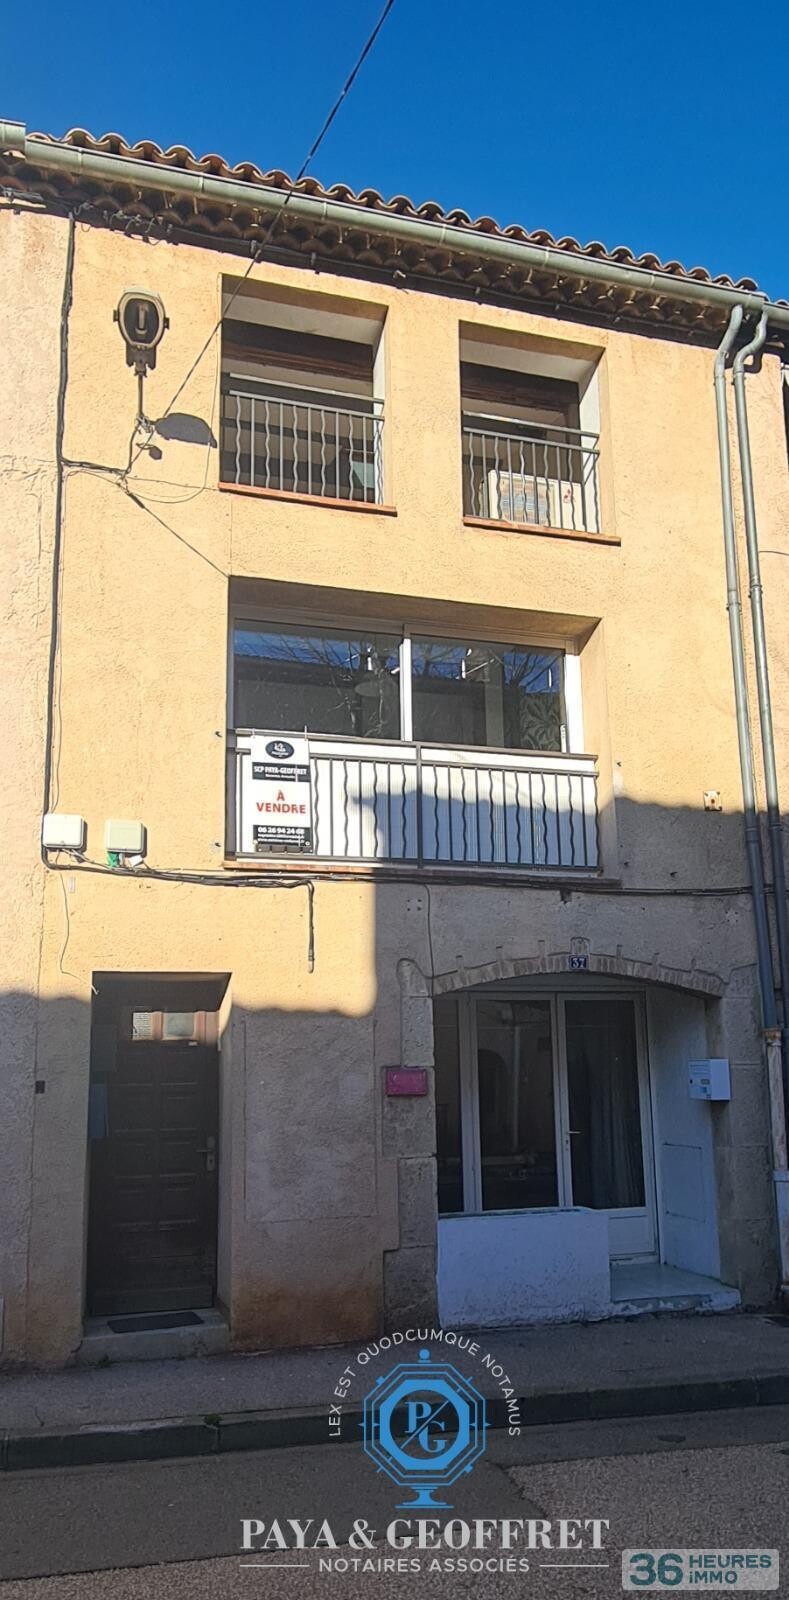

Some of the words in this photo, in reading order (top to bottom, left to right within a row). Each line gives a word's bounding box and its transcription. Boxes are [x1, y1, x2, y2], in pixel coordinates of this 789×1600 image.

[277, 789, 285, 801] À
[256, 802, 306, 814] VENDRE
[572, 957, 585, 968] 37
